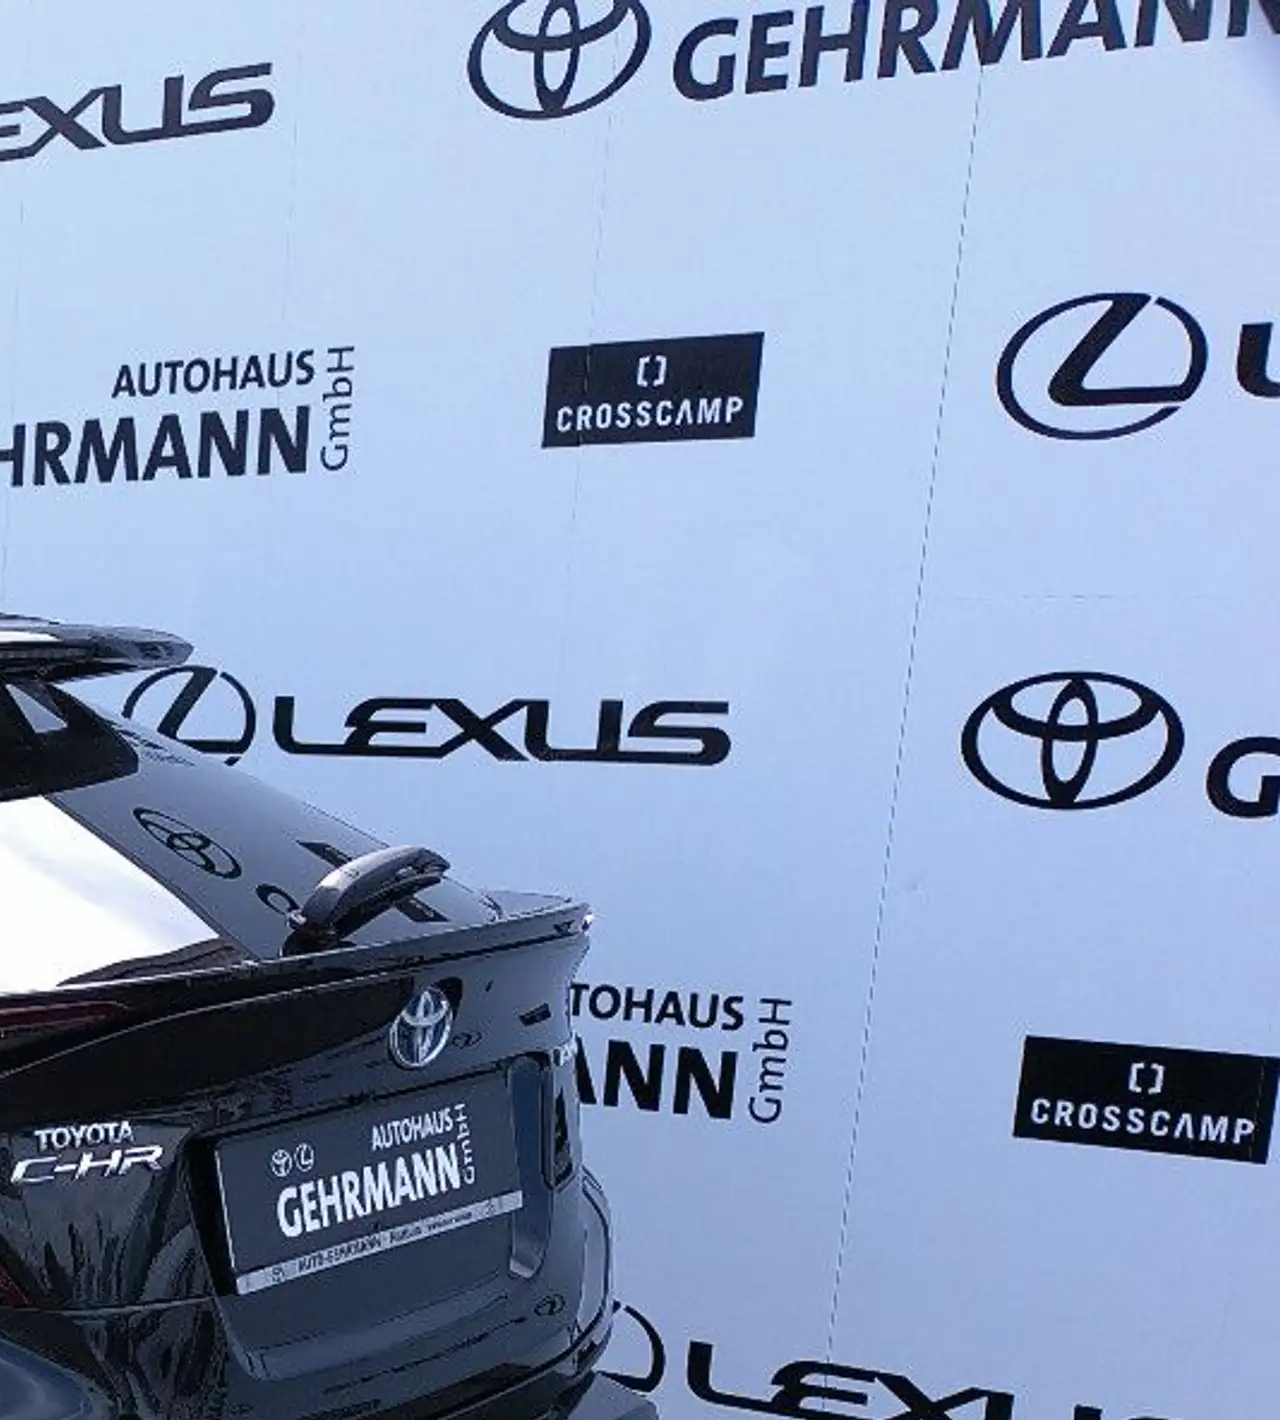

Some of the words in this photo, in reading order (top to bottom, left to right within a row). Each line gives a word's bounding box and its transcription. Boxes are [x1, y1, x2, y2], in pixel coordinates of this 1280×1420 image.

[111, 349, 316, 400] AUTOHAUS
[319, 345, 356, 472] GmbH
[555, 395, 744, 433] CROSSCAMP
[272, 695, 731, 768] LEXUS
[570, 982, 744, 1031] TOHAUS
[748, 997, 793, 1124] GmbH
[34, 1120, 135, 1151] TOYOTA
[371, 1107, 455, 1151] AUTOHAUS
[1030, 1096, 1256, 1147] CROSSCAMP
[10, 1144, 163, 1184] C-HR
[276, 1142, 462, 1238] GEHRMANN
